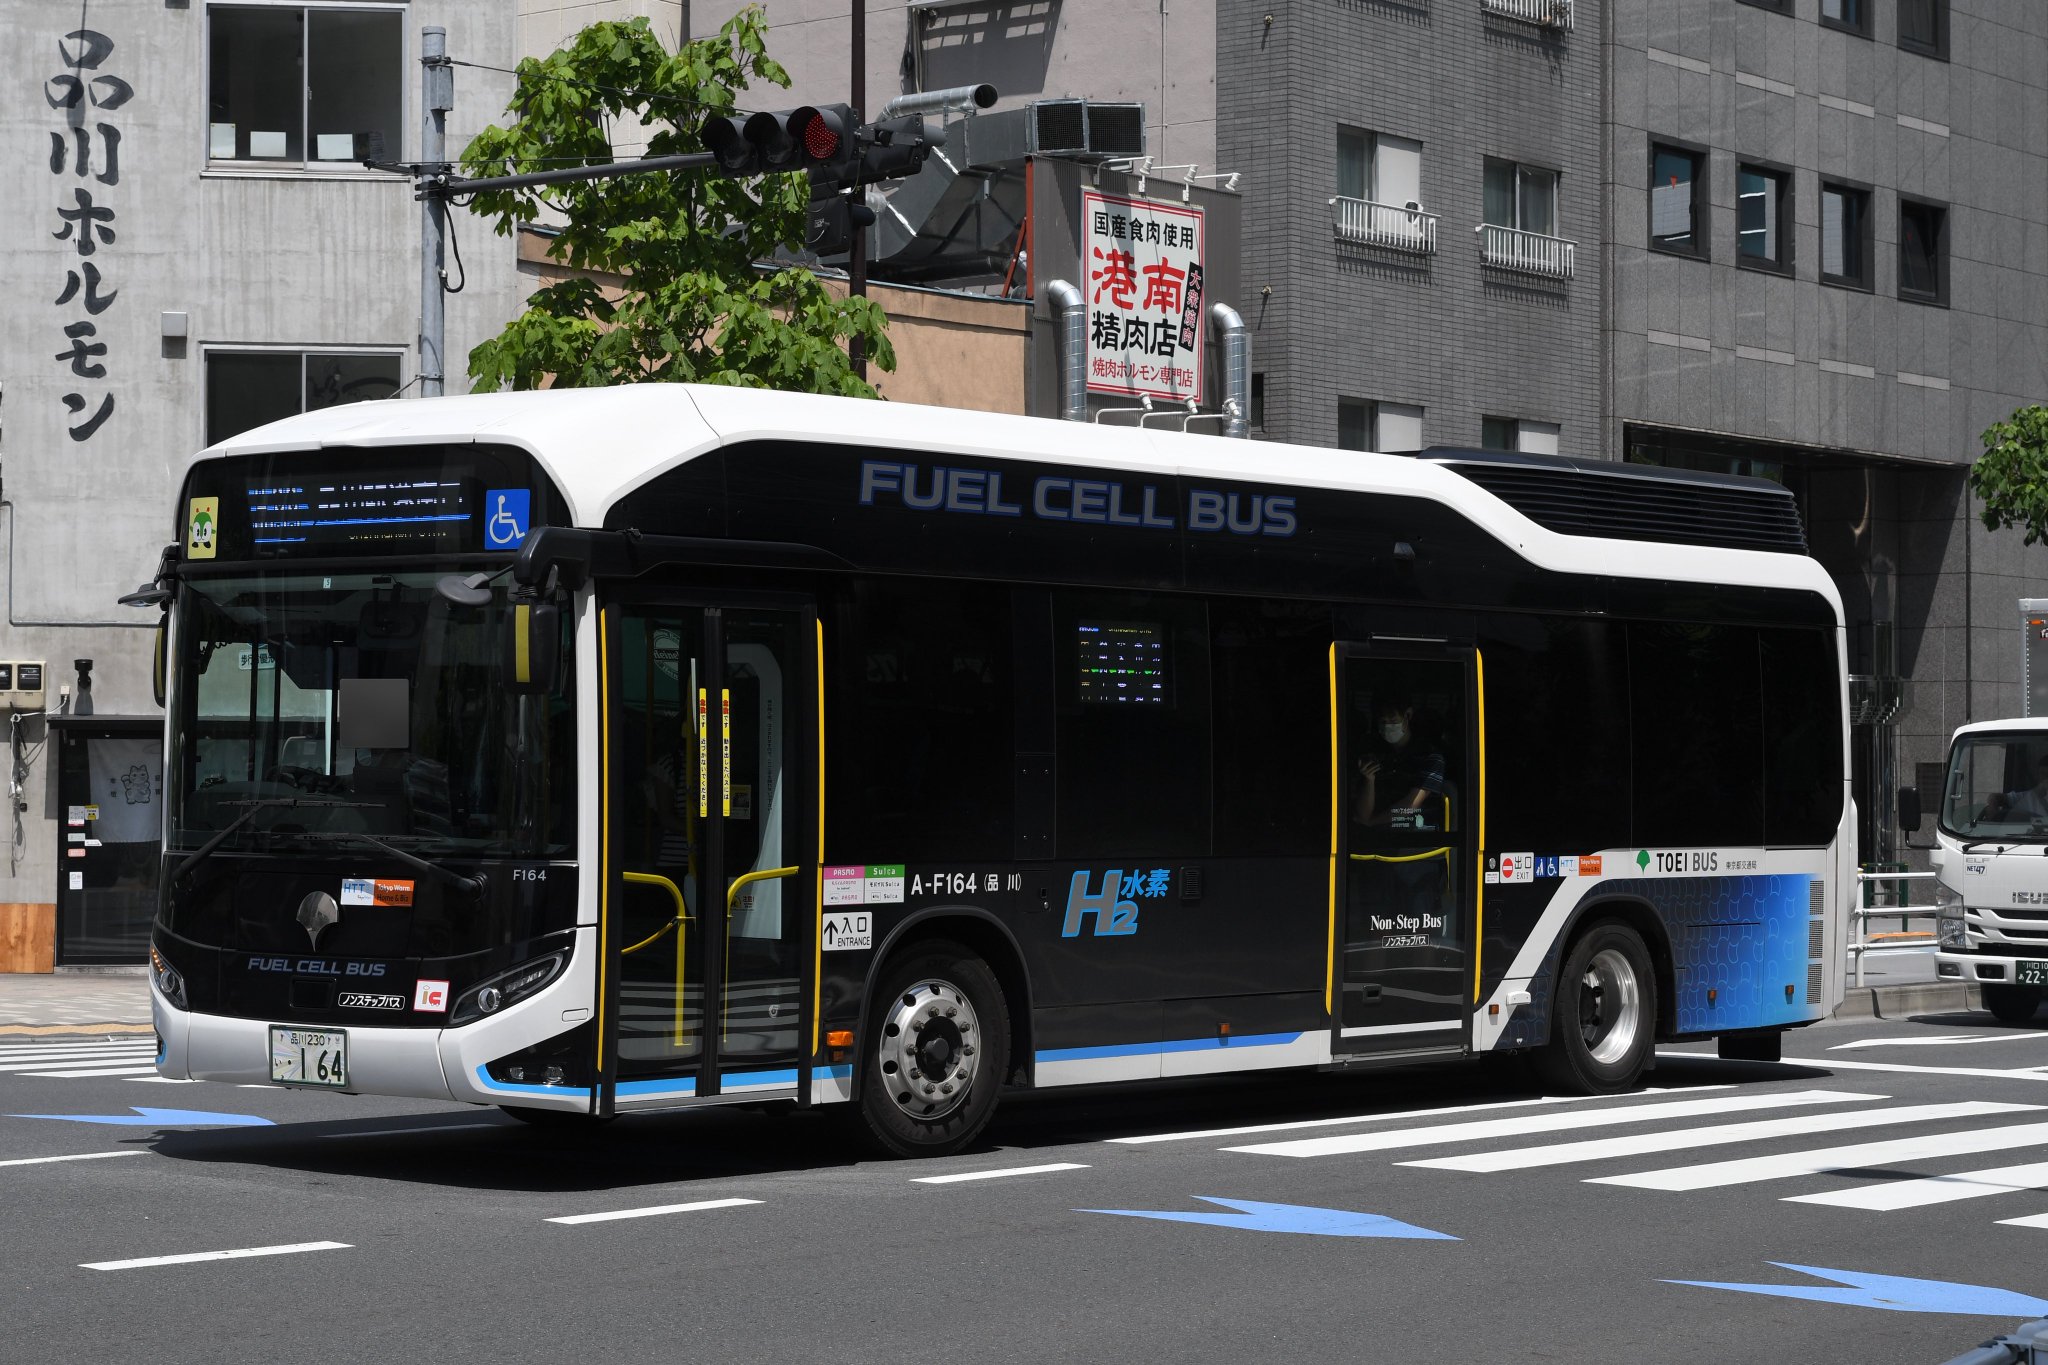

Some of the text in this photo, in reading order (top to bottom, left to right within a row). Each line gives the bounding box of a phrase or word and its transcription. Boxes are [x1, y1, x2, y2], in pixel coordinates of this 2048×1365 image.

[45, 30, 134, 442] 品川ホルモン
[1094, 211, 1194, 250] 国産食肉使用
[1092, 247, 1186, 314] 港南
[1091, 311, 1177, 357] 精肉店
[1092, 357, 1193, 387] 焼肉ホルモン専門店
[859, 460, 1297, 536] FUEL CELL BUS
[1514, 856, 1532, 869] 出口
[1656, 852, 1718, 872] TOEI BUS
[513, 869, 547, 881] F164
[911, 872, 977, 896] A-F164
[1120, 868, 1171, 899] 水素
[1516, 871, 1530, 880] EXIT
[377, 884, 411, 892] Tokyo Warm
[842, 917, 867, 934] 入口
[1422, 913, 1442, 929] Bus
[837, 936, 871, 947] ENTRANCE
[1385, 936, 1427, 947] ノンステップバス
[248, 958, 386, 976] FUEL CELL BUS
[342, 994, 400, 1008] ノンステップバス
